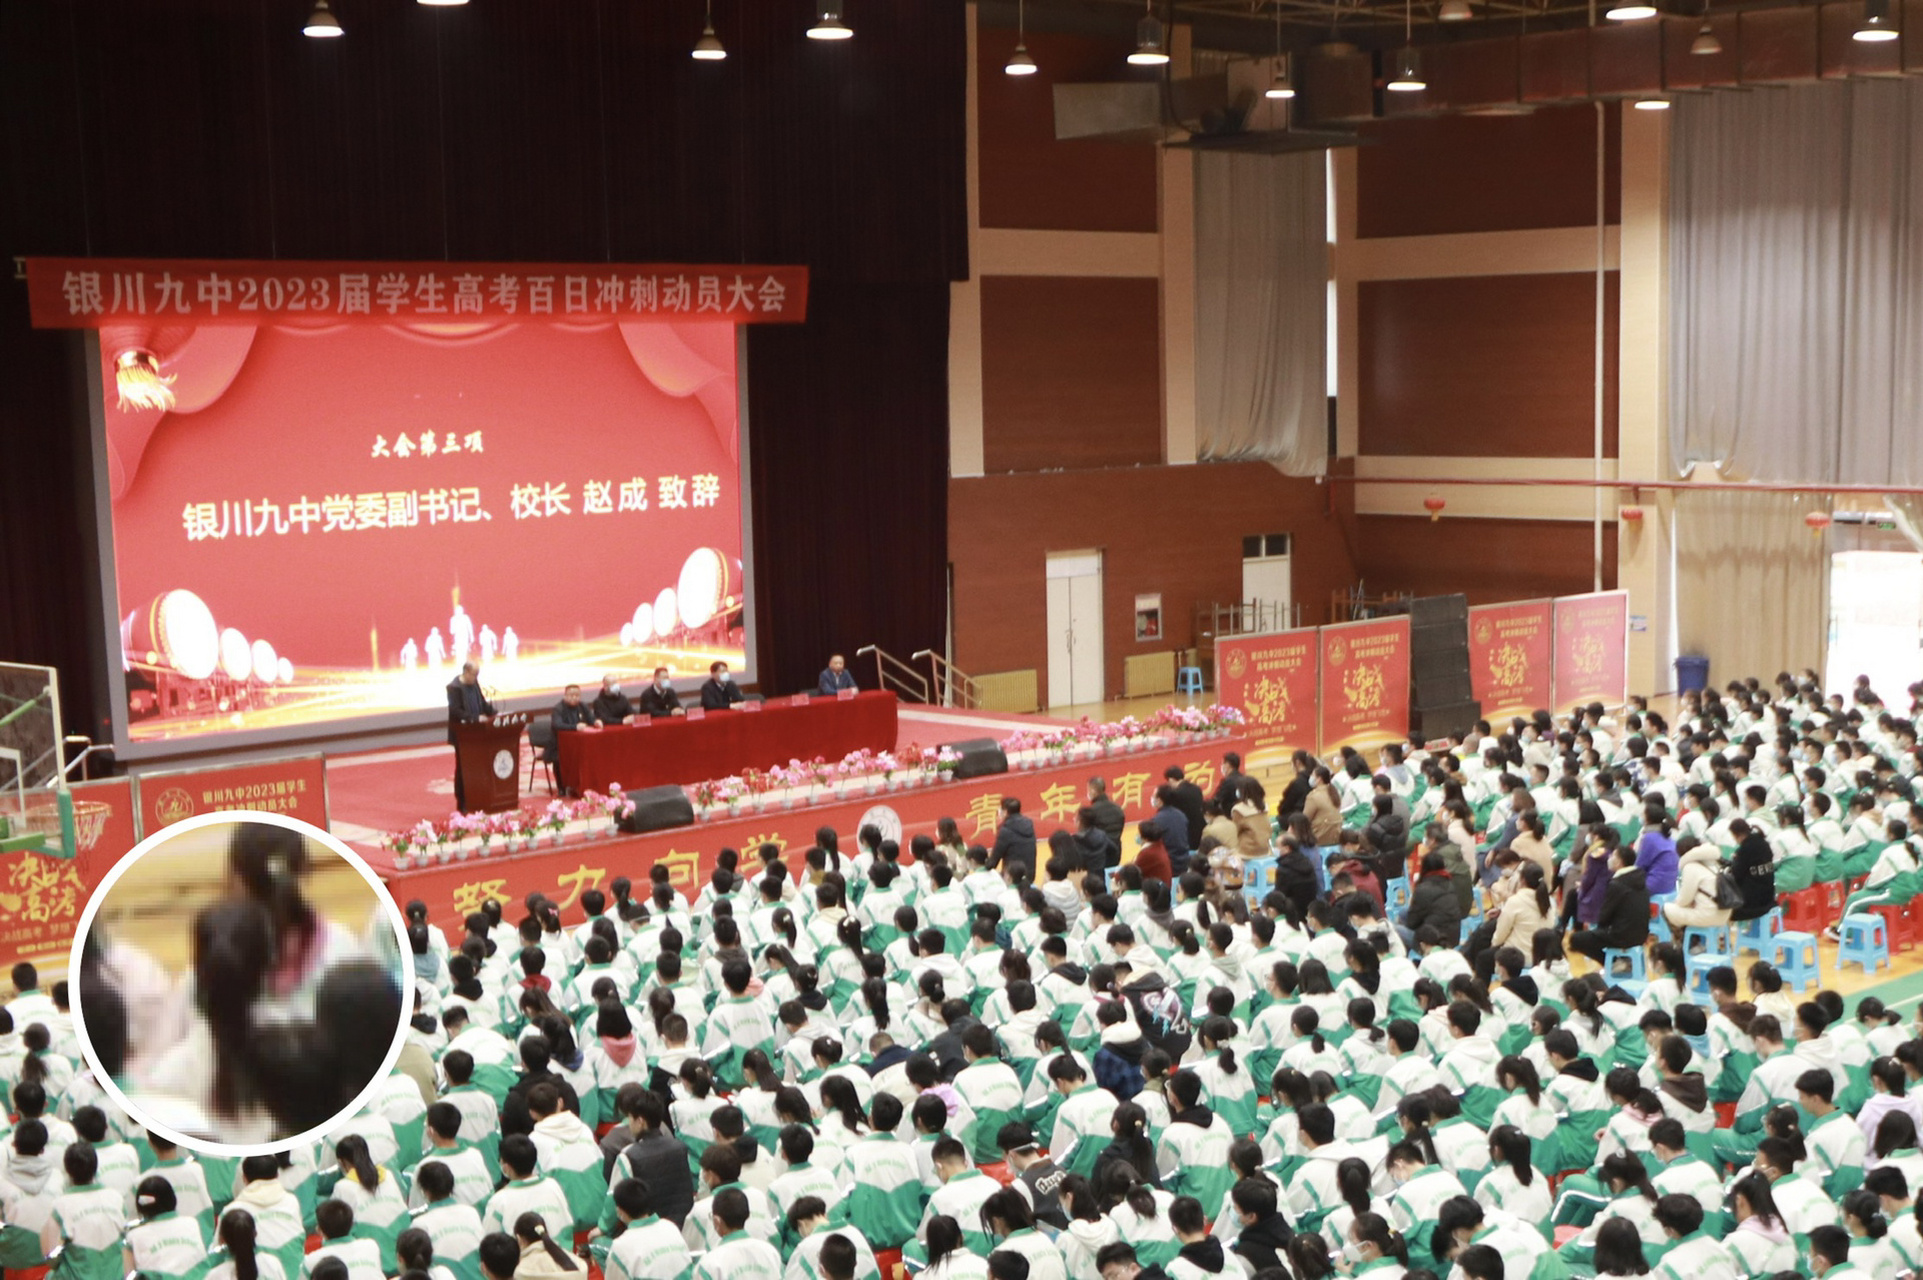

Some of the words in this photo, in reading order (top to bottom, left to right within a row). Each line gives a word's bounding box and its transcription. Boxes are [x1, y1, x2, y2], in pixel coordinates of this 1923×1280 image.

[62, 271, 786, 316] 银川九中2023届学生高考百日冲刺动员大会
[371, 429, 484, 458] 大会第三项
[510, 481, 571, 520] 校长
[658, 472, 720, 509] 致辞
[202, 779, 307, 805] 银川九中2023届学生
